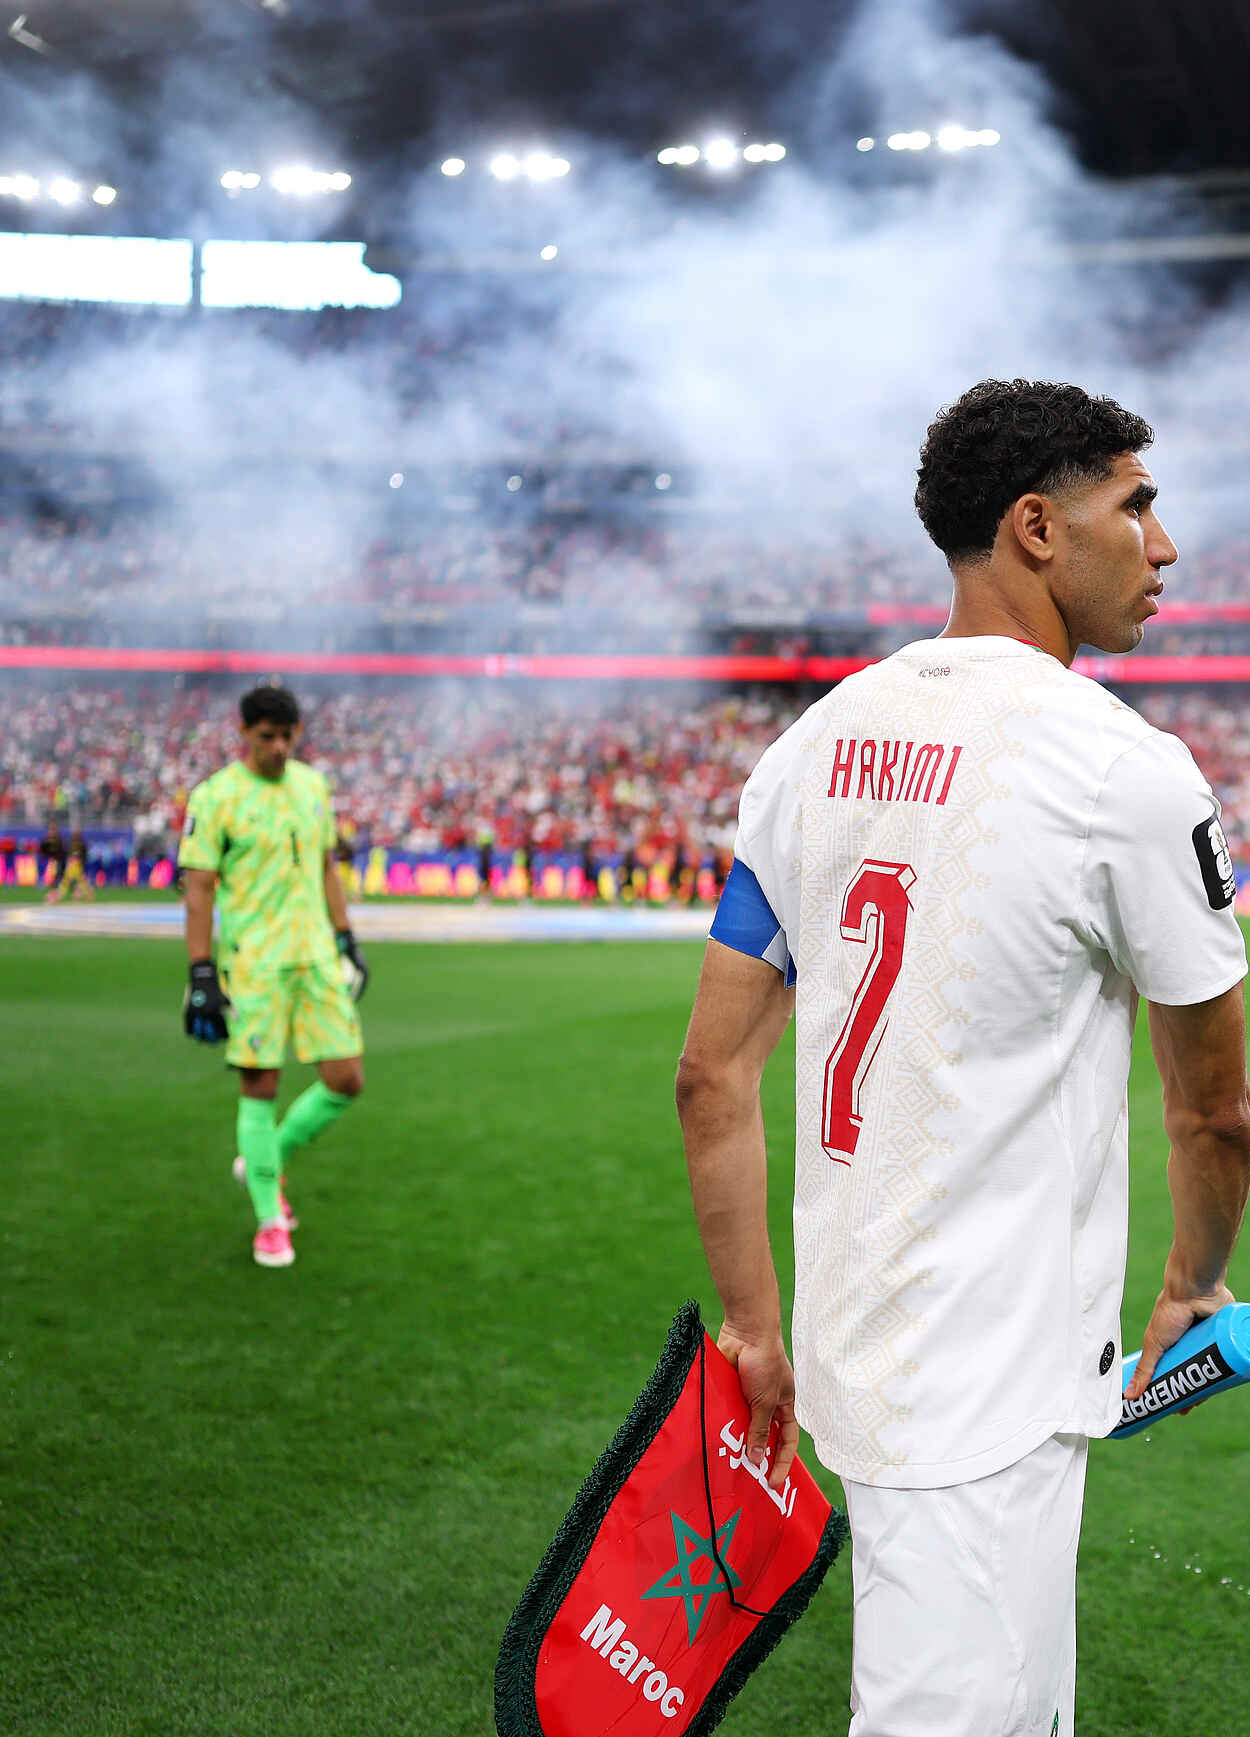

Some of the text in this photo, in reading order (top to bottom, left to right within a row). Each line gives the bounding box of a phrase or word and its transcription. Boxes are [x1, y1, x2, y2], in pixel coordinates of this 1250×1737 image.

[828, 739, 963, 806] HAKIMI
[821, 858, 918, 1167] 2
[1117, 1354, 1223, 1427] POWERAD
[579, 1604, 685, 1718] Maroc
